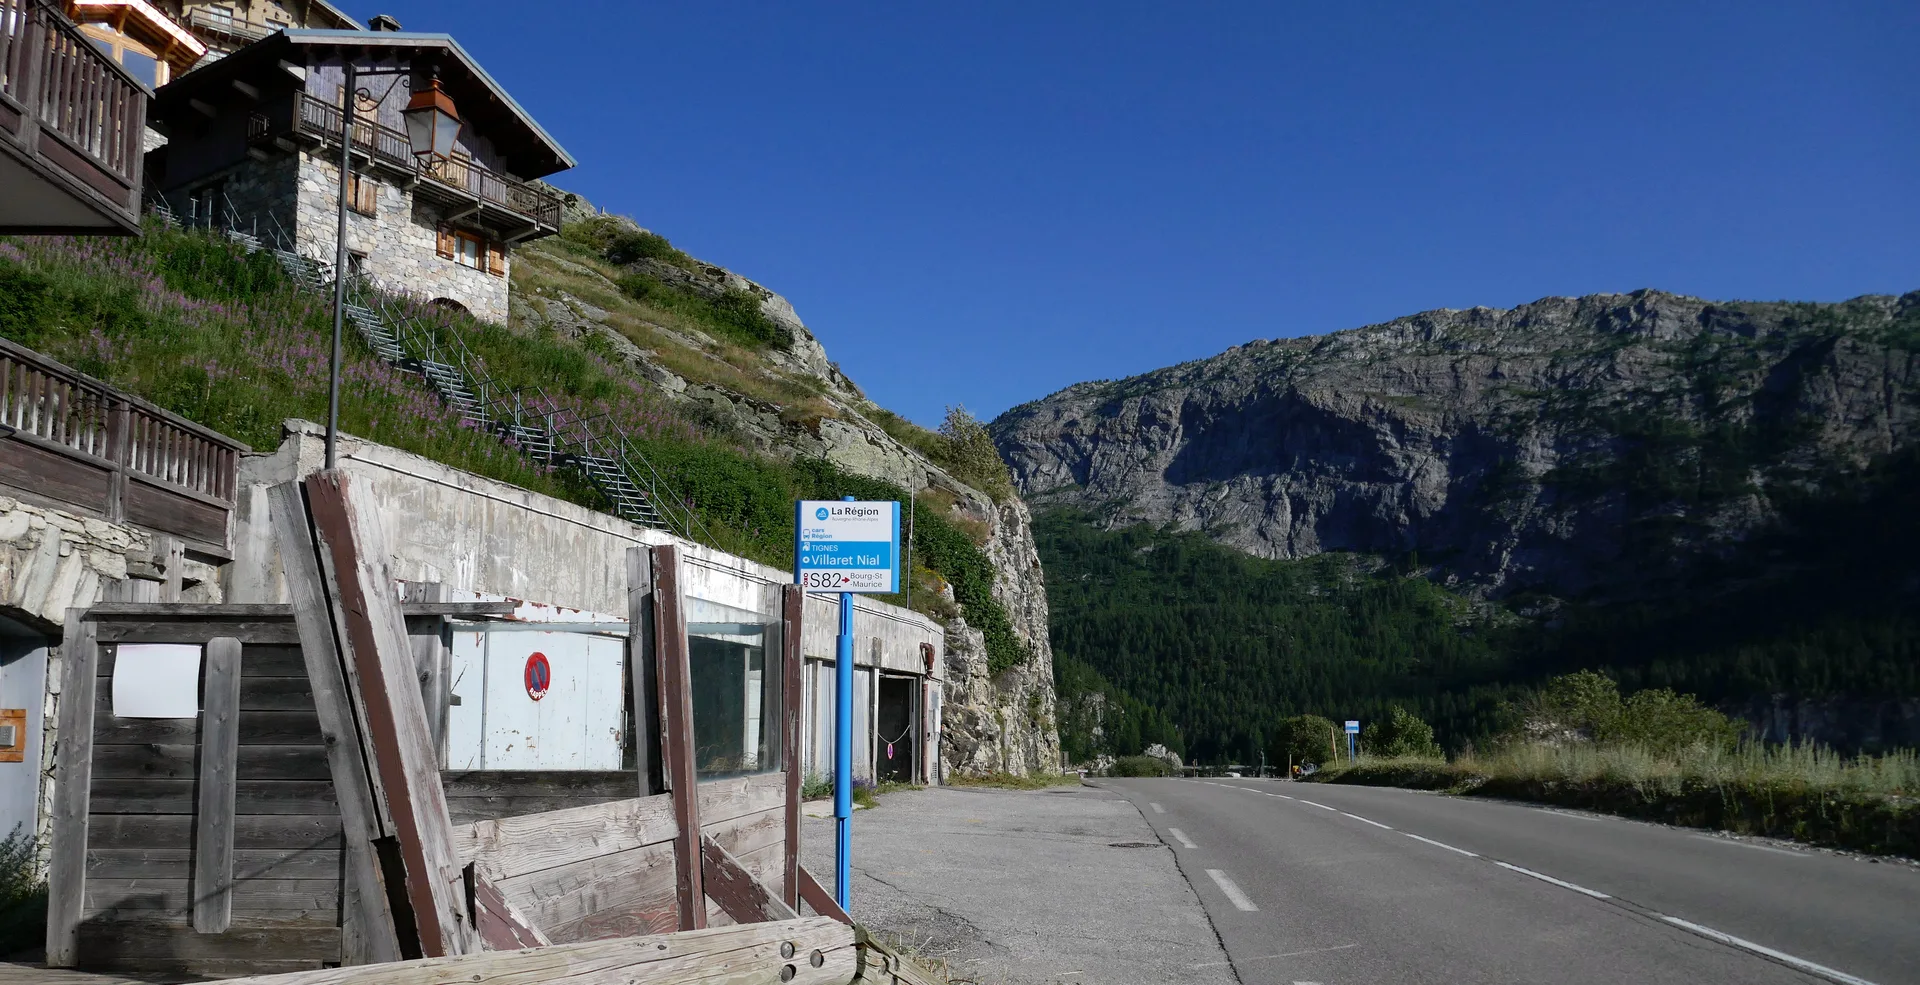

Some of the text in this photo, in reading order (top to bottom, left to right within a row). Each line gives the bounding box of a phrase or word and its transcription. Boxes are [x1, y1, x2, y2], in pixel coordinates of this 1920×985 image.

[832, 506, 879, 517] La Région
[811, 555, 880, 566] Villaret Nial
[810, 572, 841, 588] S82
[850, 573, 882, 581] Bourg-St
